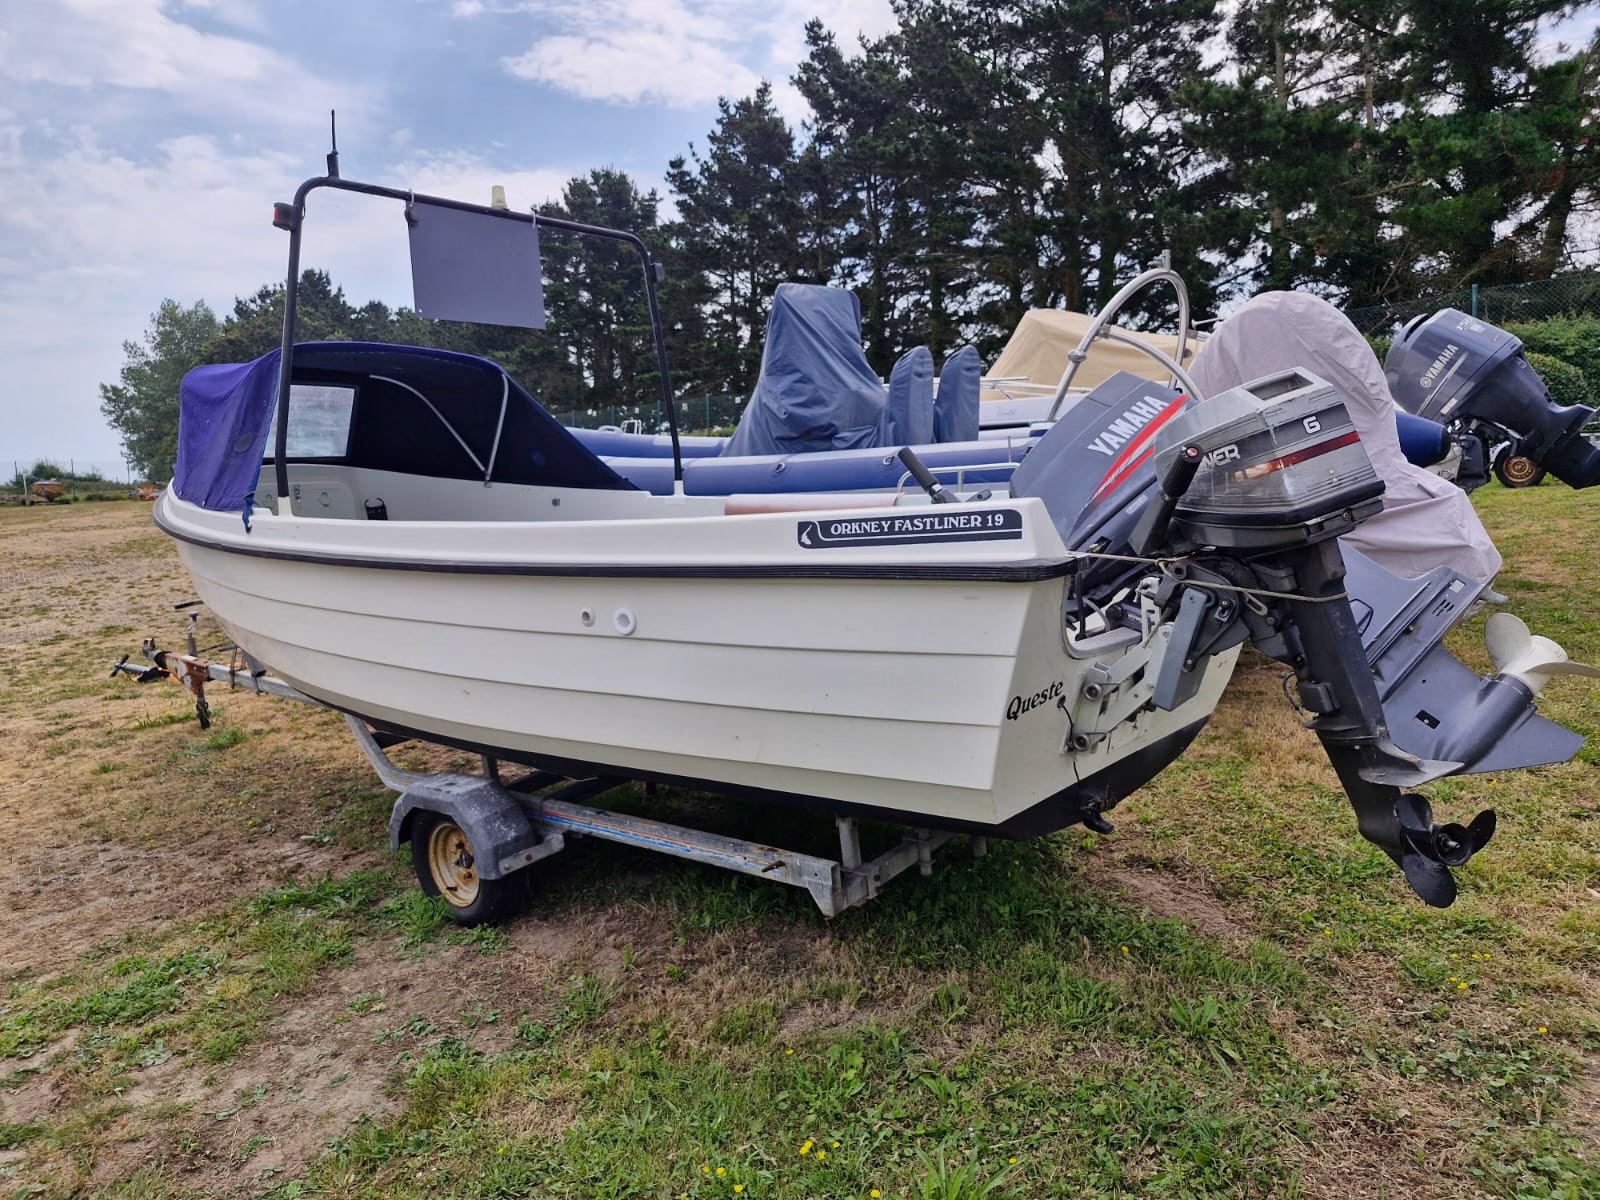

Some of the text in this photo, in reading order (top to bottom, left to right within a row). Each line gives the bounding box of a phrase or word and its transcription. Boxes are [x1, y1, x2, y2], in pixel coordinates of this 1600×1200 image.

[1424, 344, 1459, 379] YAMAHA
[1087, 395, 1170, 456] YAMAHA
[1302, 415, 1321, 434] 6
[1200, 444, 1241, 468] NER
[830, 513, 1004, 535] ORKNEY FASTLINER 19
[1006, 680, 1064, 721] Queste
